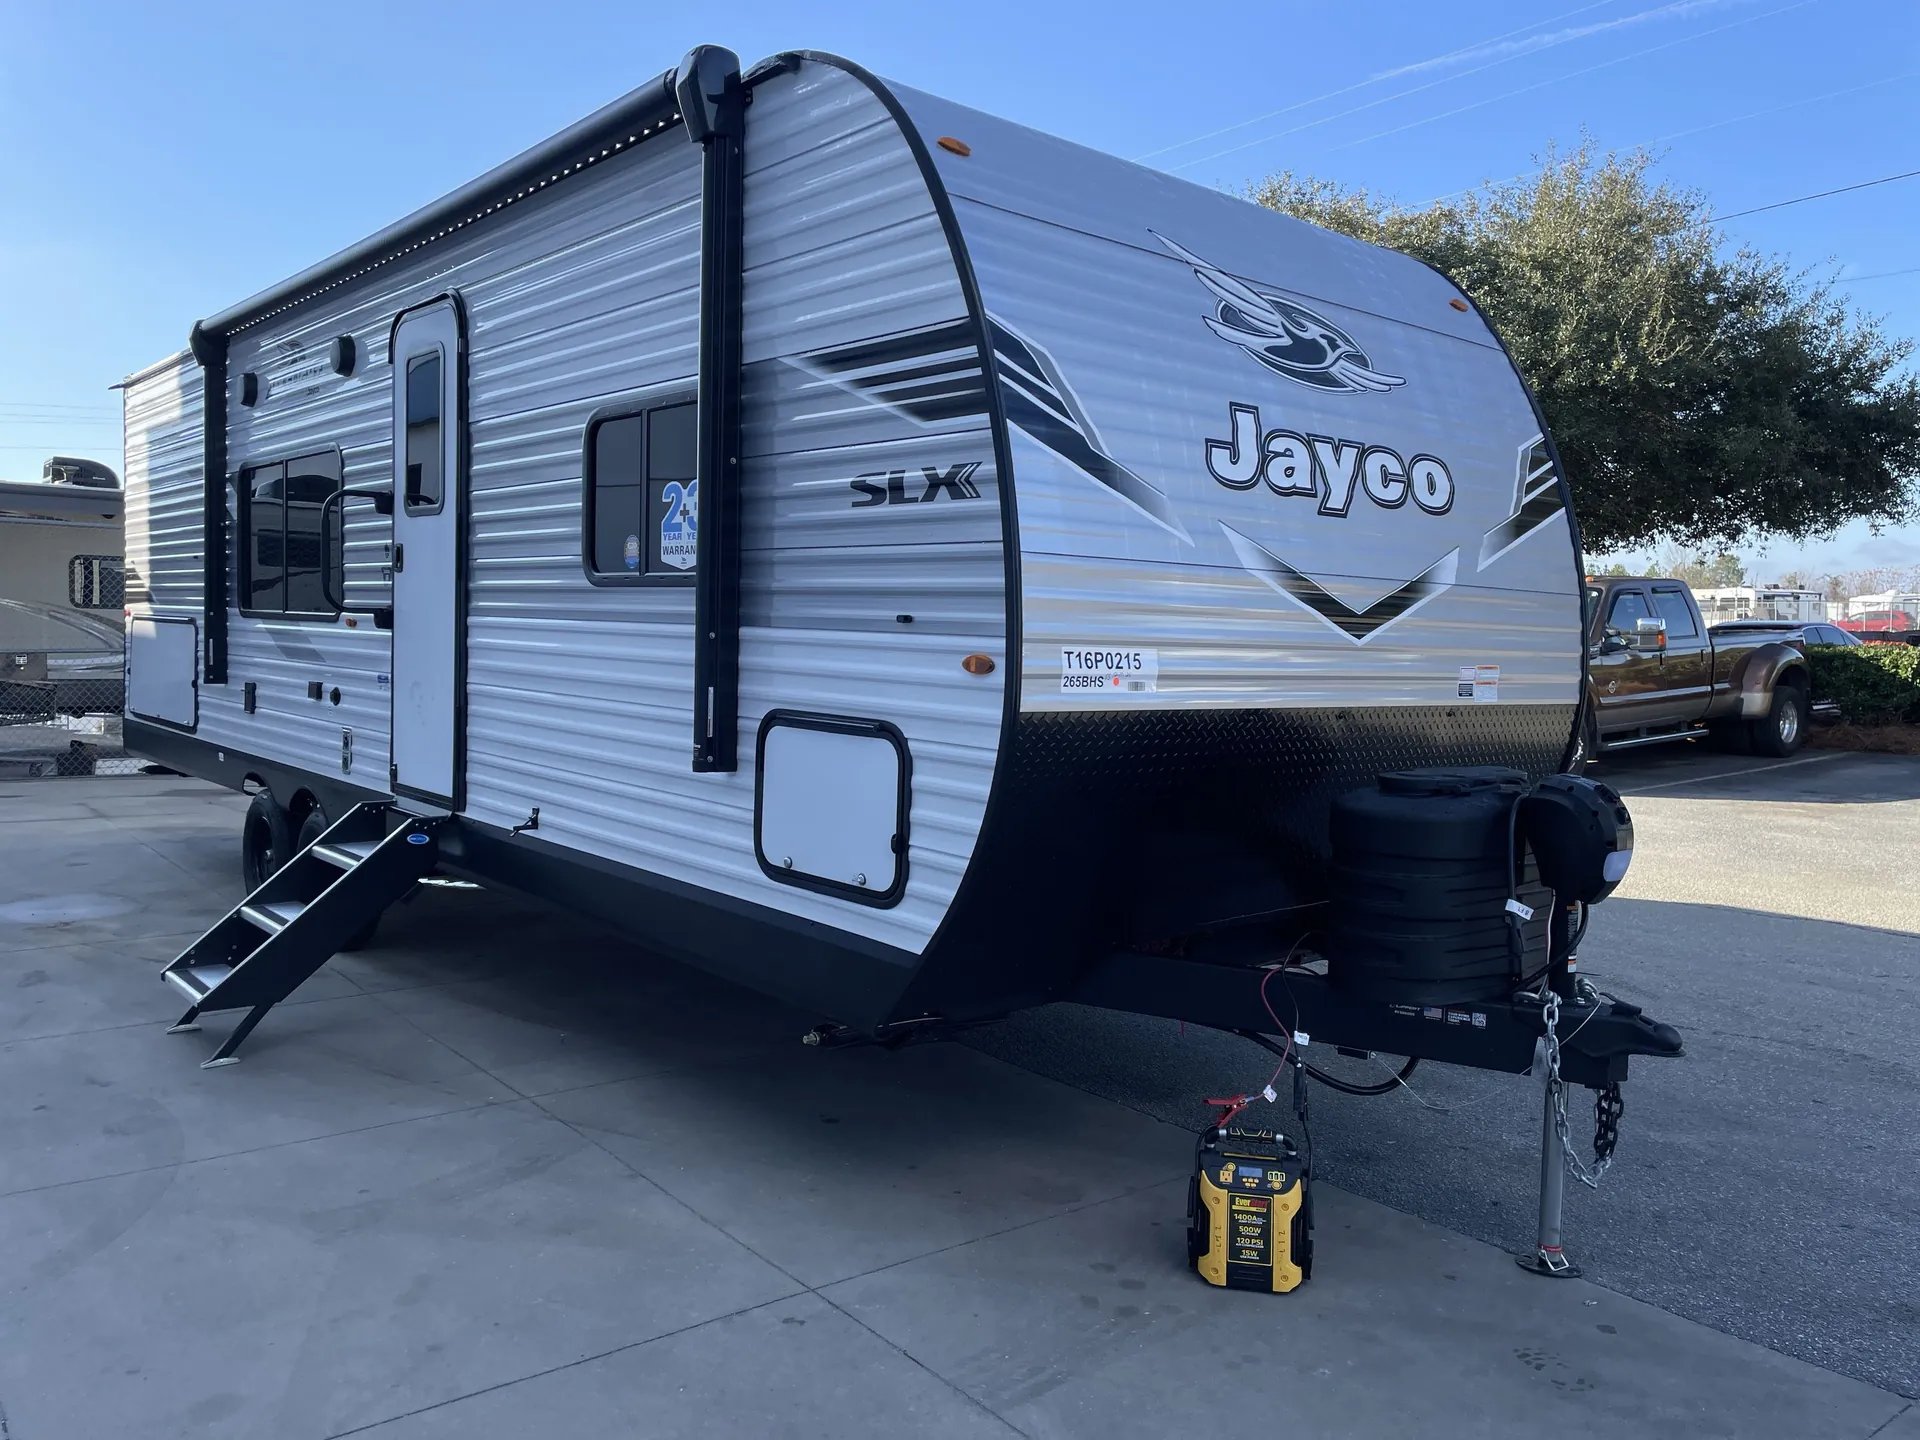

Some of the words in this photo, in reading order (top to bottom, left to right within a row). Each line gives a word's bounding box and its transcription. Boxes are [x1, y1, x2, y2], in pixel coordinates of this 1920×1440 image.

[1205, 401, 1454, 518] Jayco
[850, 461, 983, 507] SLX
[663, 532, 682, 541] YEAR
[687, 531, 697, 540] YE
[662, 545, 696, 556] WARRAN
[1063, 651, 1142, 670] T16P0215
[1062, 675, 1104, 688] 265BHS
[1233, 1213, 1257, 1221] 1400A
[1239, 1225, 1261, 1234] 500W
[1251, 1238, 1264, 1246] PSI
